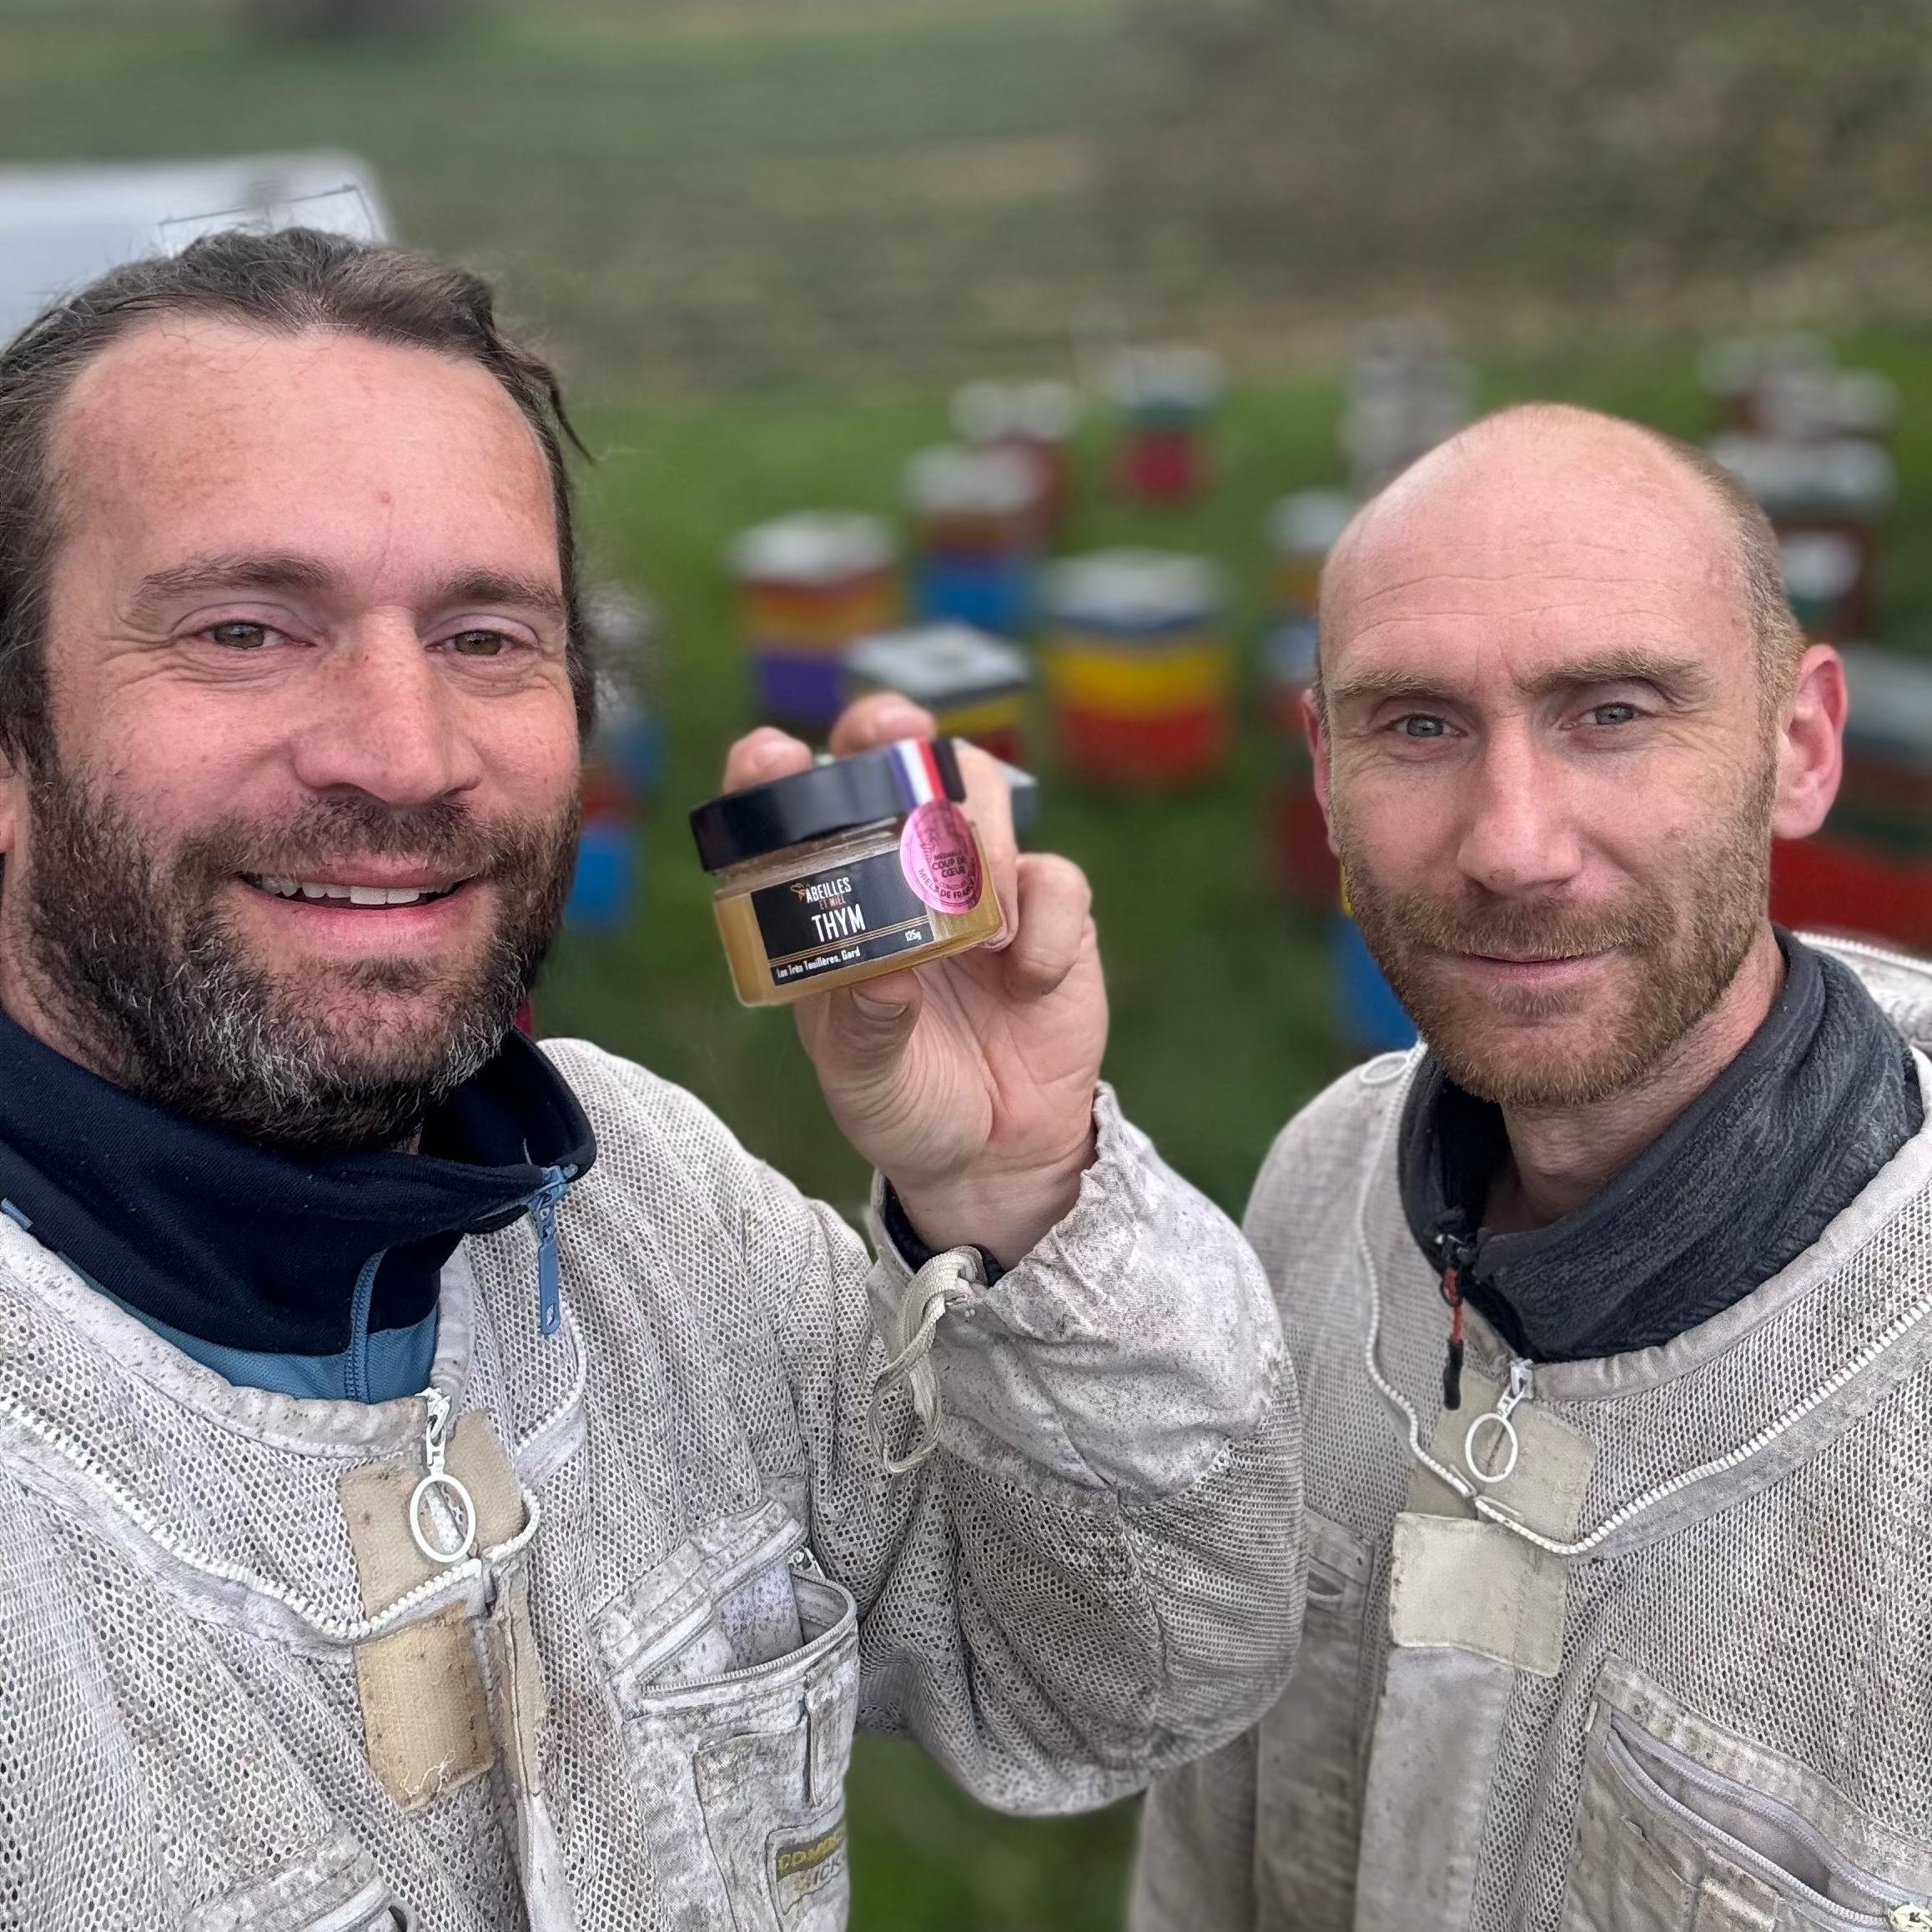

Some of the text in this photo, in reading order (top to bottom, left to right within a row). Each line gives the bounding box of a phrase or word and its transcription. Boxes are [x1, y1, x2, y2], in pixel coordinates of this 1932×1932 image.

[932, 858, 955, 870] COUP
[806, 877, 852, 903] ABEILLES
[940, 889, 952, 898] DE
[818, 893, 847, 910] ET MIEL
[811, 903, 866, 943] THYM
[904, 928, 923, 943] 125g
[840, 945, 861, 960] Gard
